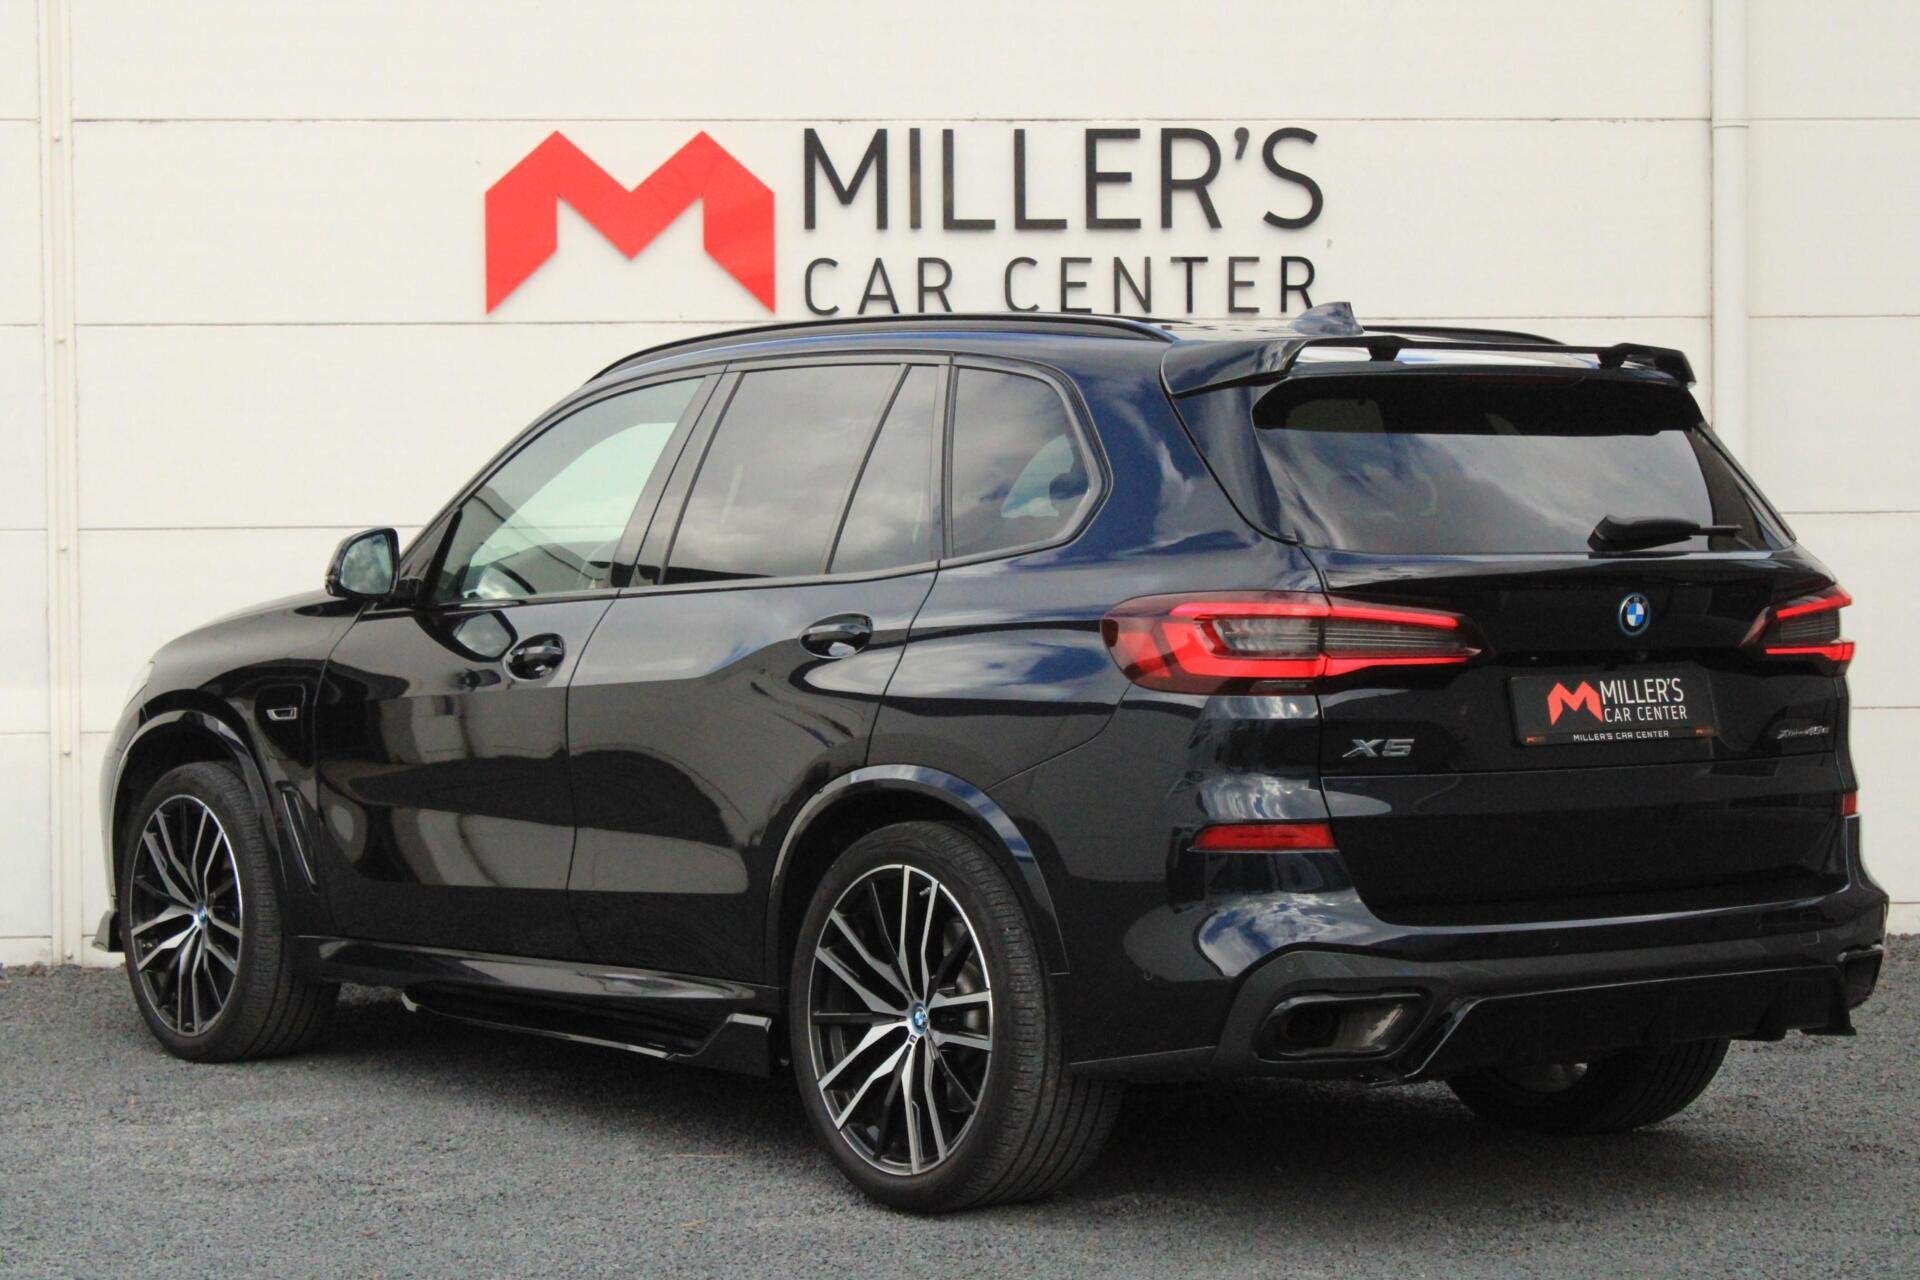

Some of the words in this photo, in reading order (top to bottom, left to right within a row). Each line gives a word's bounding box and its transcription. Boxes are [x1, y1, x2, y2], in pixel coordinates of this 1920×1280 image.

[803, 127, 1324, 231] MILLER'S
[803, 256, 953, 316] CAR
[1004, 256, 1316, 314] CENTER
[1600, 678, 1684, 704] MILLER'S
[1604, 708, 1632, 722] CAR
[1637, 705, 1687, 721] CENTER
[1573, 732, 1613, 742] MILLER'S
[1615, 731, 1634, 740] CAR
[1635, 729, 1669, 739] CENTER
[1342, 738, 1415, 758] X5
